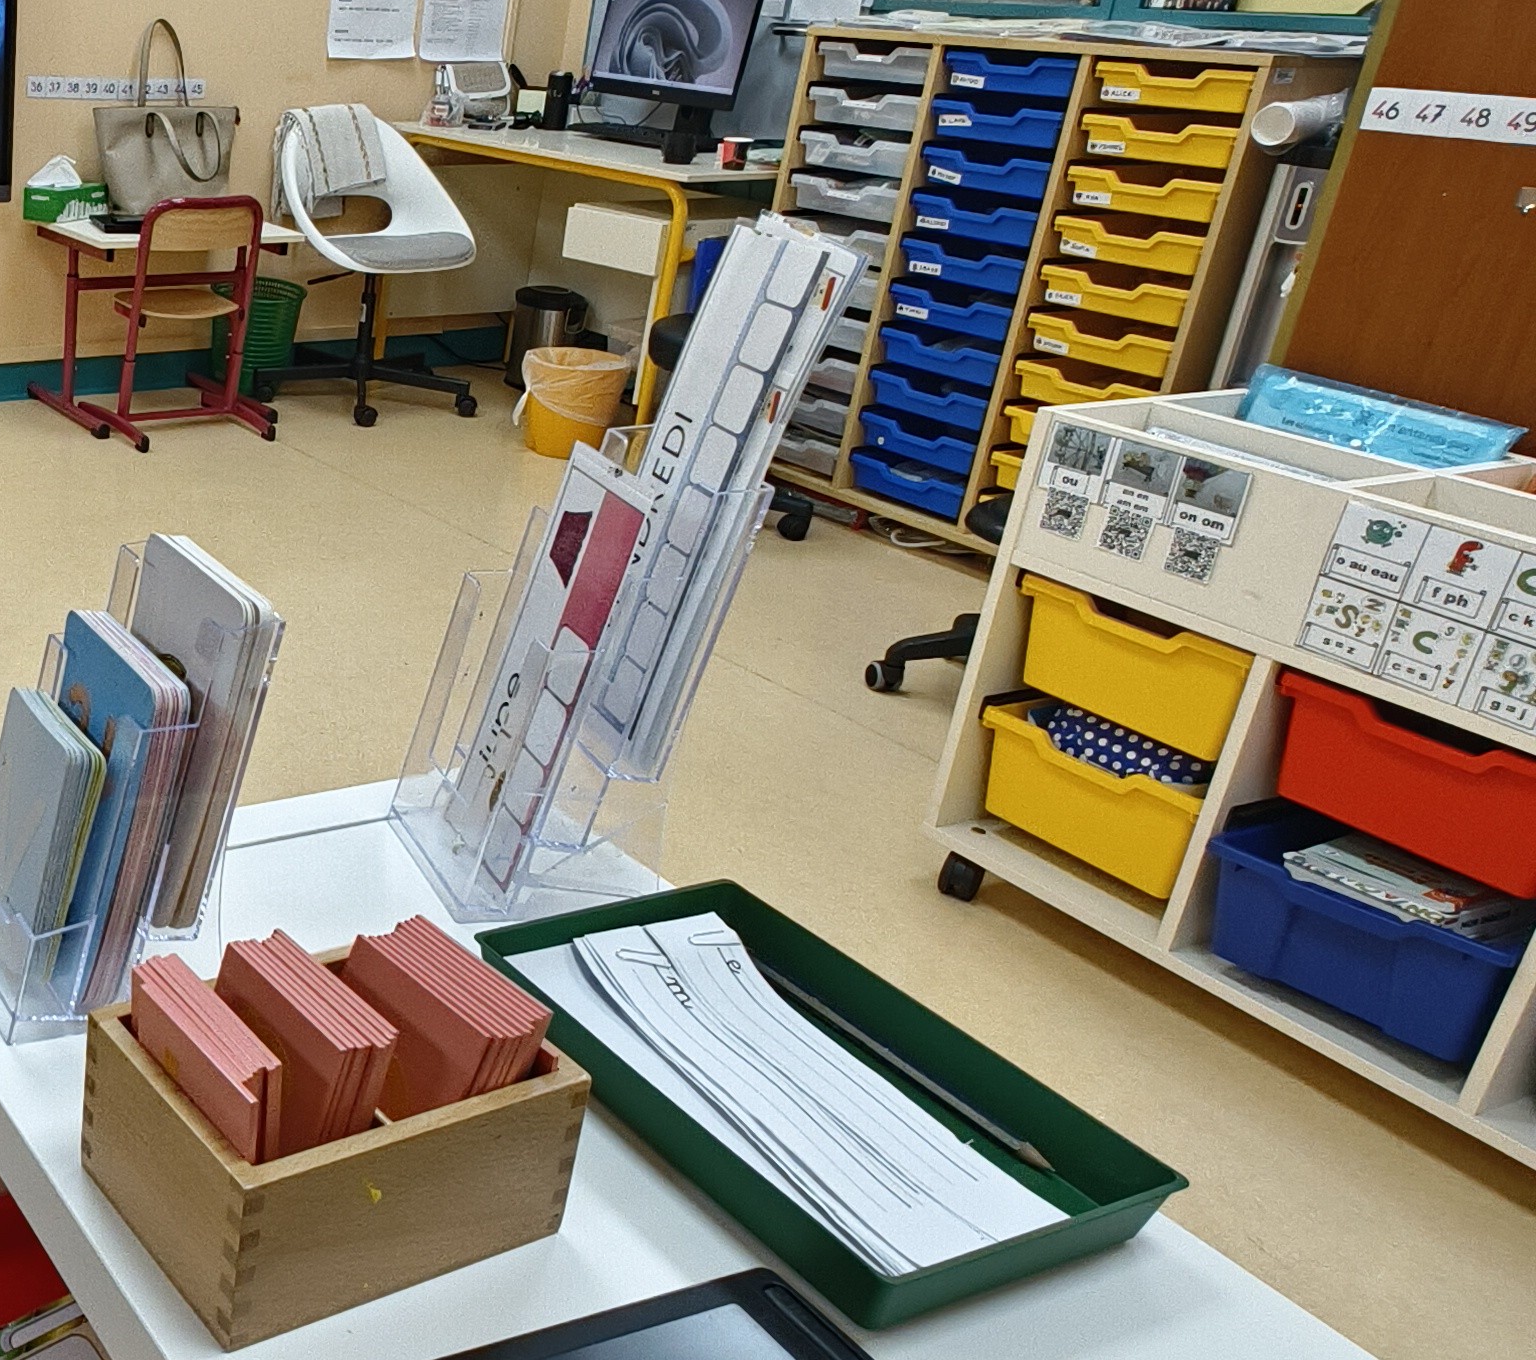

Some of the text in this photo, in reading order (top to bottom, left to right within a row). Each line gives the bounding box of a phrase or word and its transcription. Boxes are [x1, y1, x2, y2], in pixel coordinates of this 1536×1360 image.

[31, 81, 42, 92] 36
[49, 82, 61, 92] 37
[67, 82, 79, 93] 38
[85, 82, 97, 93] 39
[104, 83, 115, 93] 40
[122, 84, 134, 94] 41
[157, 84, 168, 94] 43
[191, 84, 203, 94] 45
[1372, 100, 1536, 132] 46 47 48 49
[1062, 476, 1078, 486] ou
[1180, 511, 1224, 531] on om
[1337, 556, 1398, 582] o au eau
[1432, 587, 1468, 608] f ph
[1509, 613, 1533, 627] c k
[726, 960, 741, 974] e
[666, 976, 694, 1009] m
